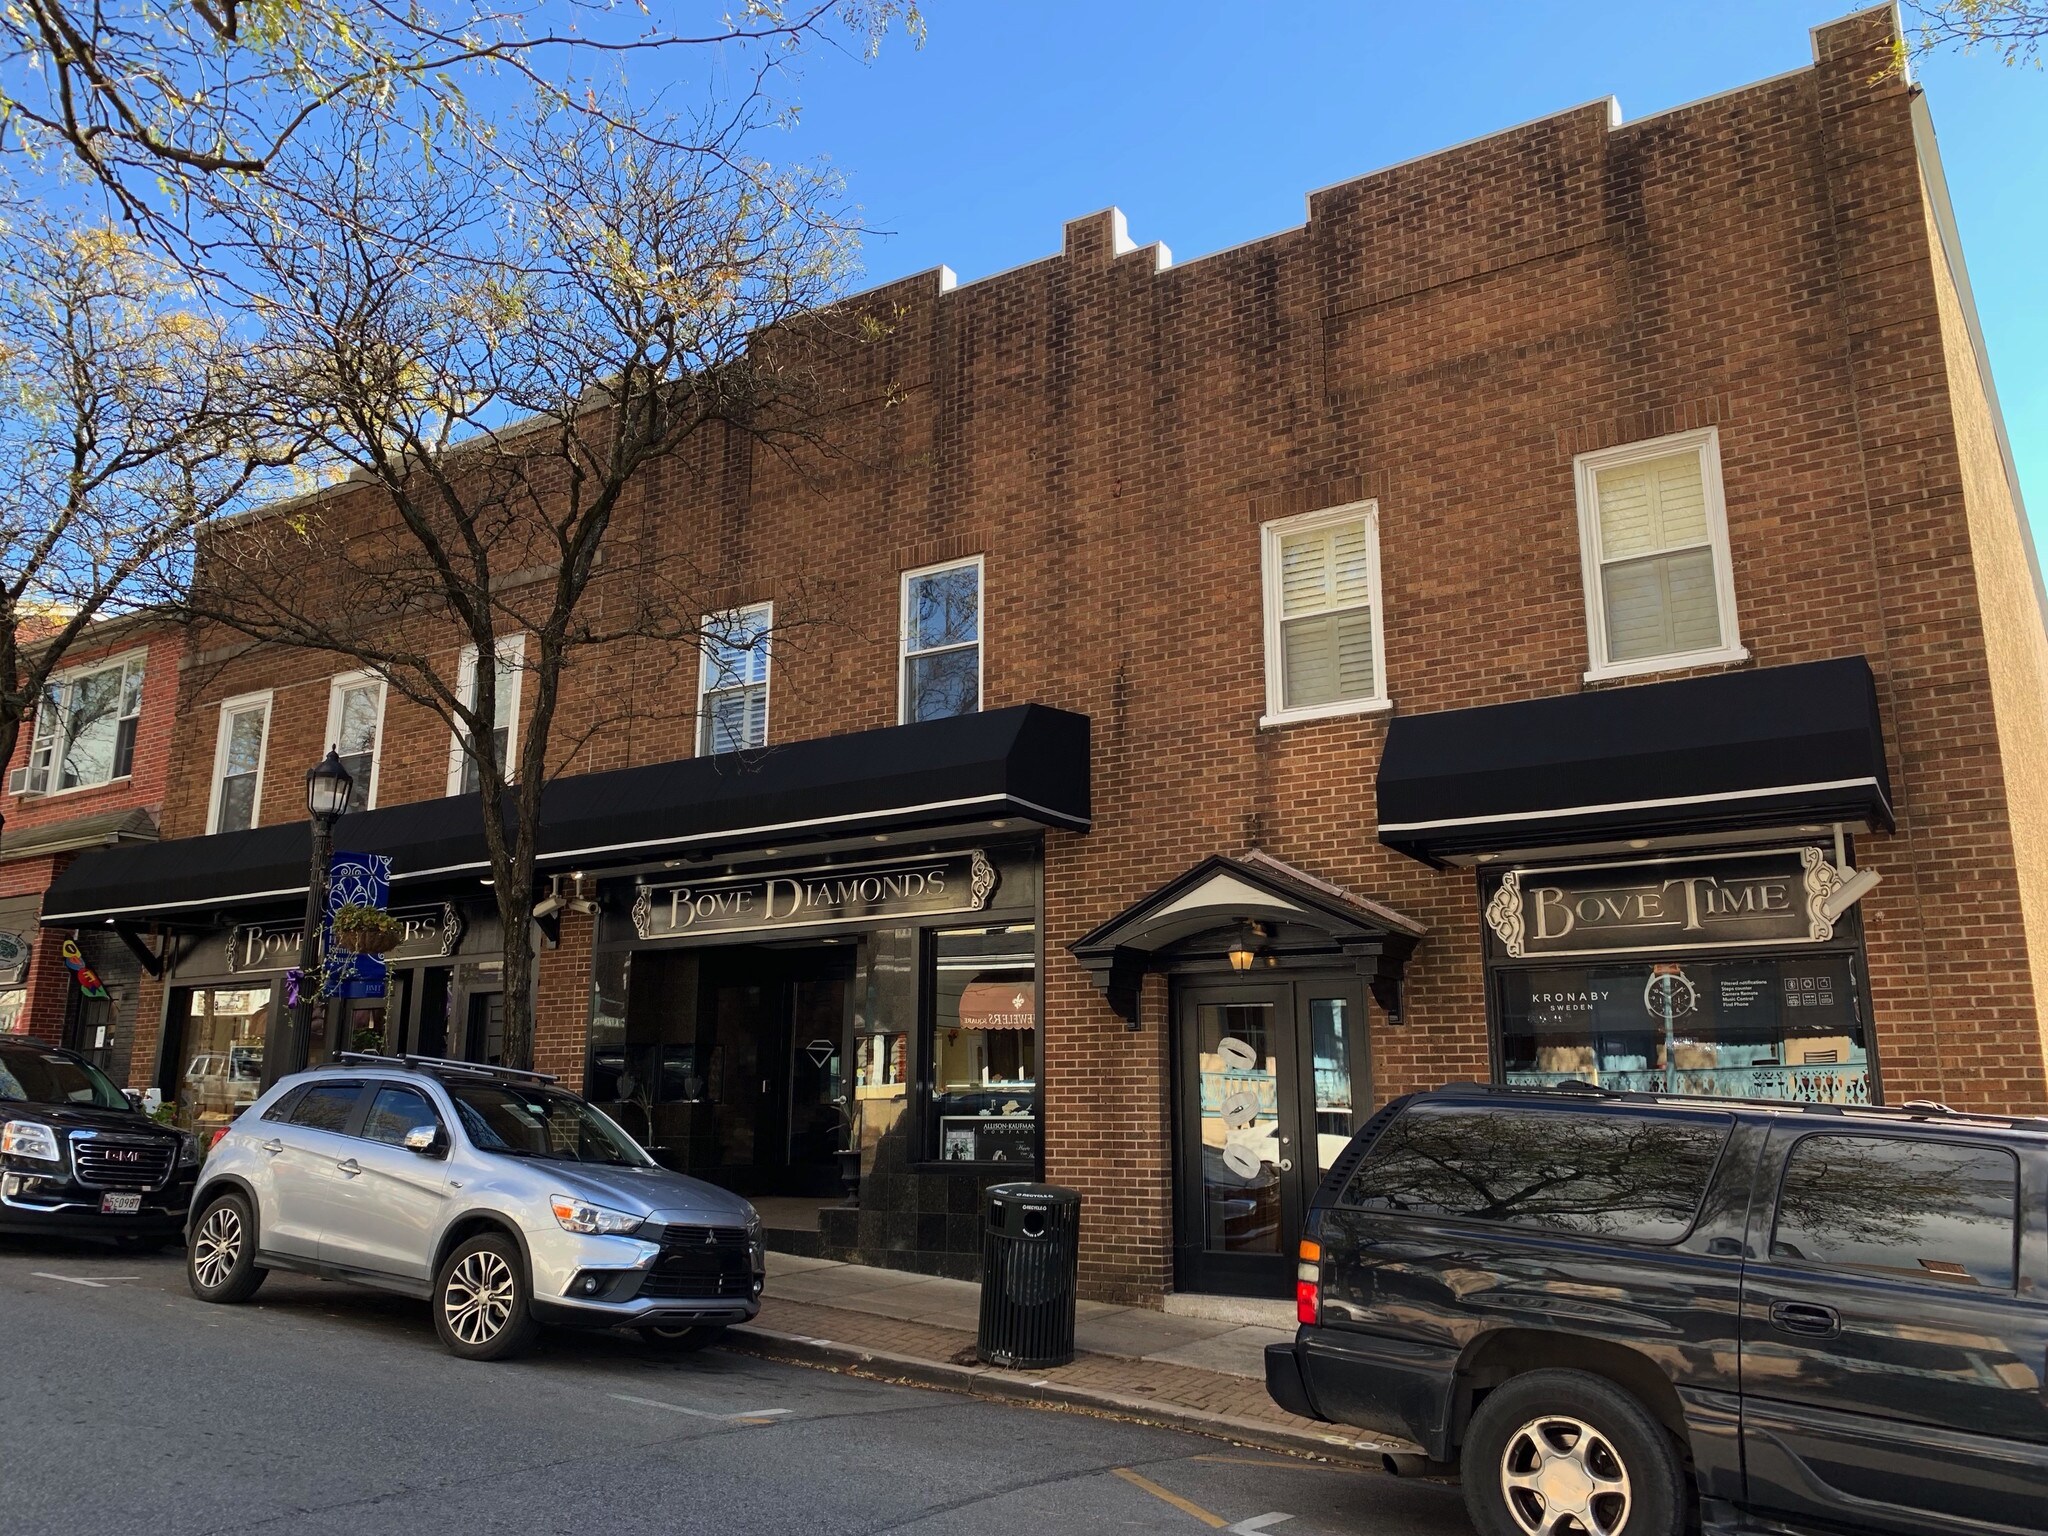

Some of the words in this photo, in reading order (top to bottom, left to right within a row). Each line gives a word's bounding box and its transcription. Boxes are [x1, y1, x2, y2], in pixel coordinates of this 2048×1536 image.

[667, 888, 754, 930] BOVE
[764, 870, 945, 921] DIAMONDS
[1529, 887, 1664, 939] BOVE
[1662, 876, 1790, 931] TIME
[1532, 991, 1609, 1002] KRONABY
[1550, 1004, 1594, 1012] SWEDEN
[106, 1150, 141, 1162] GMC
